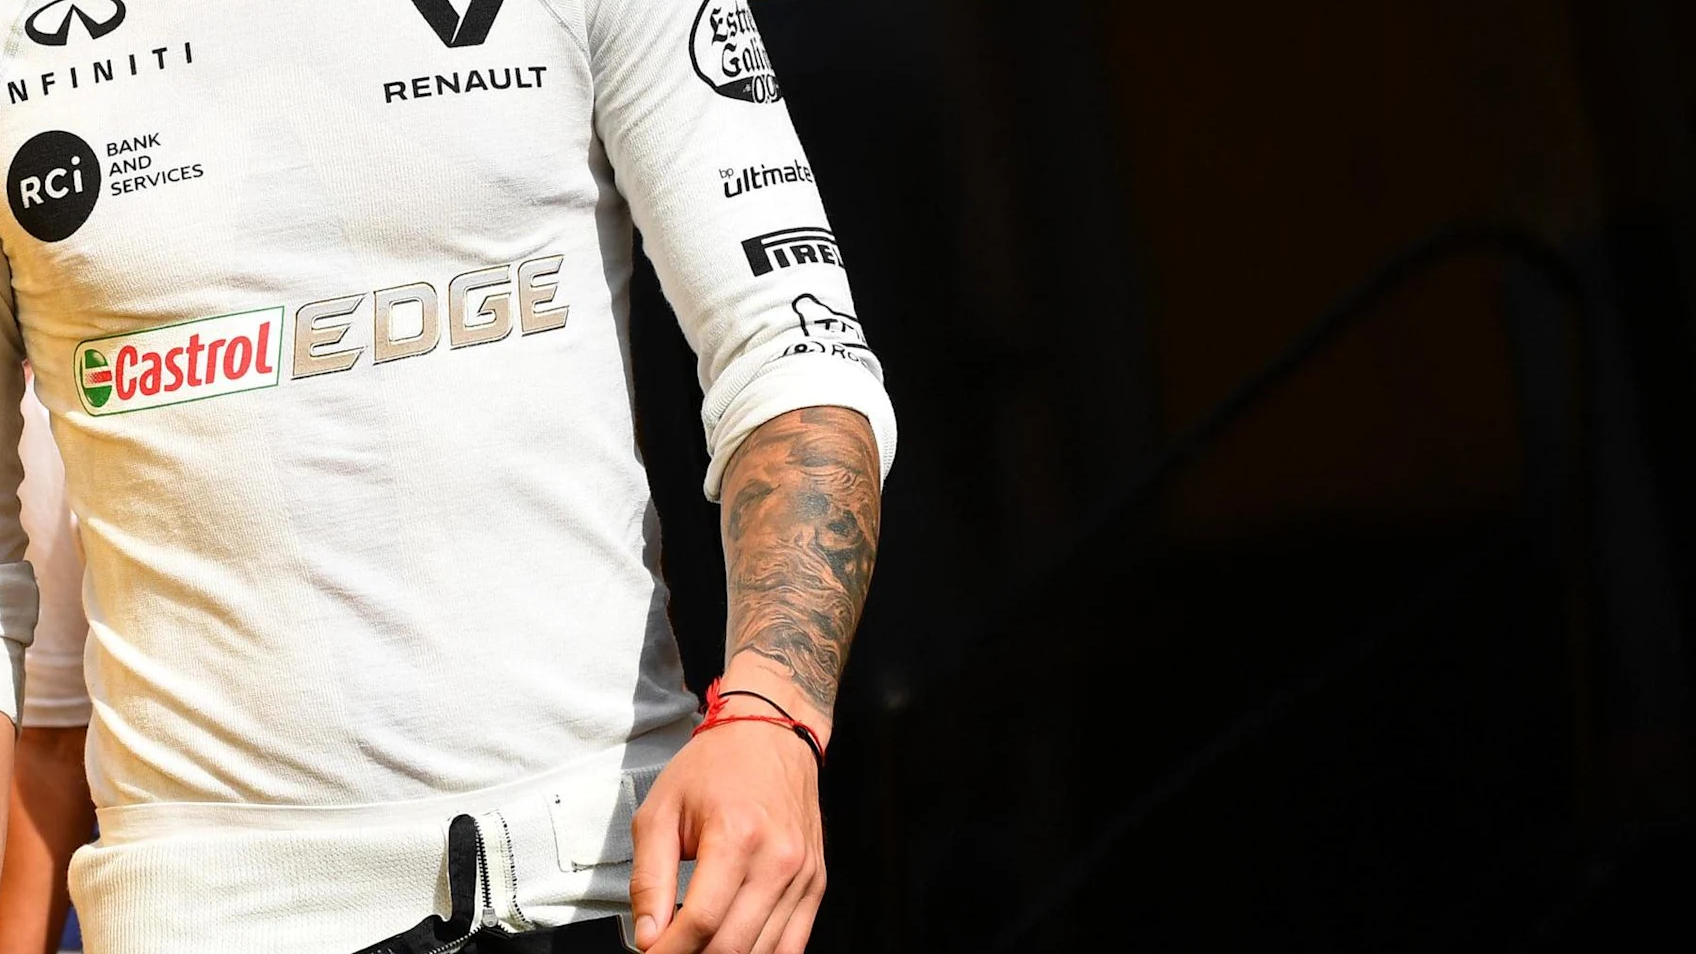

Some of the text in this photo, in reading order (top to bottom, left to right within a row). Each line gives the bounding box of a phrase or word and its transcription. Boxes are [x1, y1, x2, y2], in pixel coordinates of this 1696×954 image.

[383, 66, 547, 104] RENAULT
[106, 132, 161, 157] BANK
[109, 155, 152, 177] AND
[110, 163, 204, 196] SERVICES
[719, 168, 734, 179] bp
[724, 159, 813, 198] ultimate
[115, 254, 570, 401] Castrol EDGE
